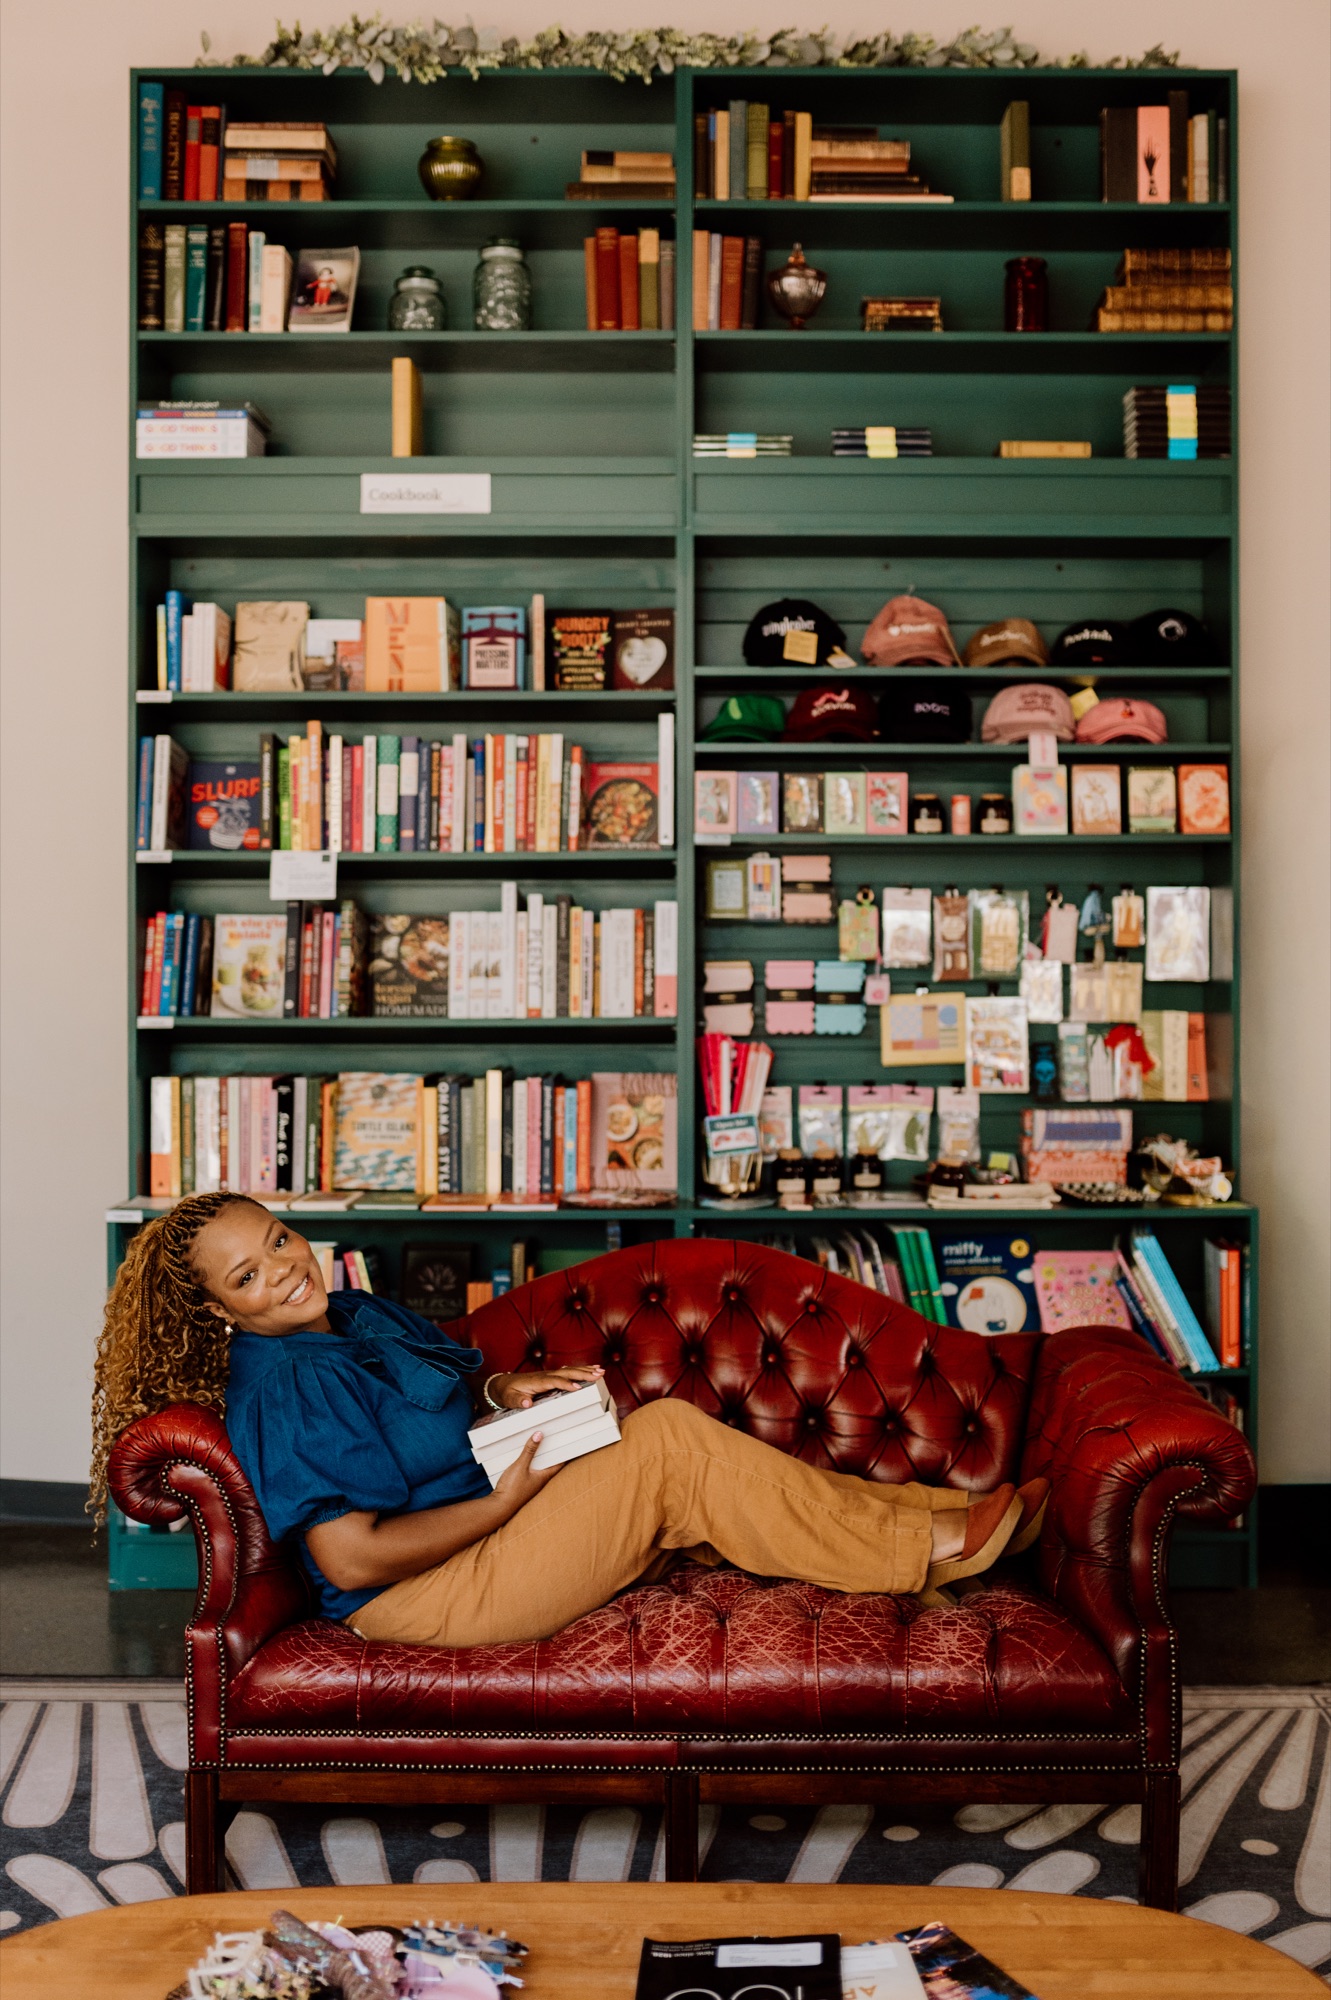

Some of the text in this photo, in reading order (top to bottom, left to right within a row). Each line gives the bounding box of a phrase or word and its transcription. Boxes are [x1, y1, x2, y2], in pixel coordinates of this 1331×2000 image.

[193, 401, 220, 410] project
[368, 487, 443, 502] Cookbook
[554, 616, 610, 632] HUNGRY
[475, 649, 509, 659] PRESSING
[475, 660, 509, 670] MATTERS
[527, 928, 542, 988] PLENTY
[374, 1004, 448, 1016] HOMEMADE
[351, 1120, 416, 1132] TURTLE ISLAND
[437, 1081, 450, 1192] OHANA STYLE
[942, 1242, 984, 1257] miffy
